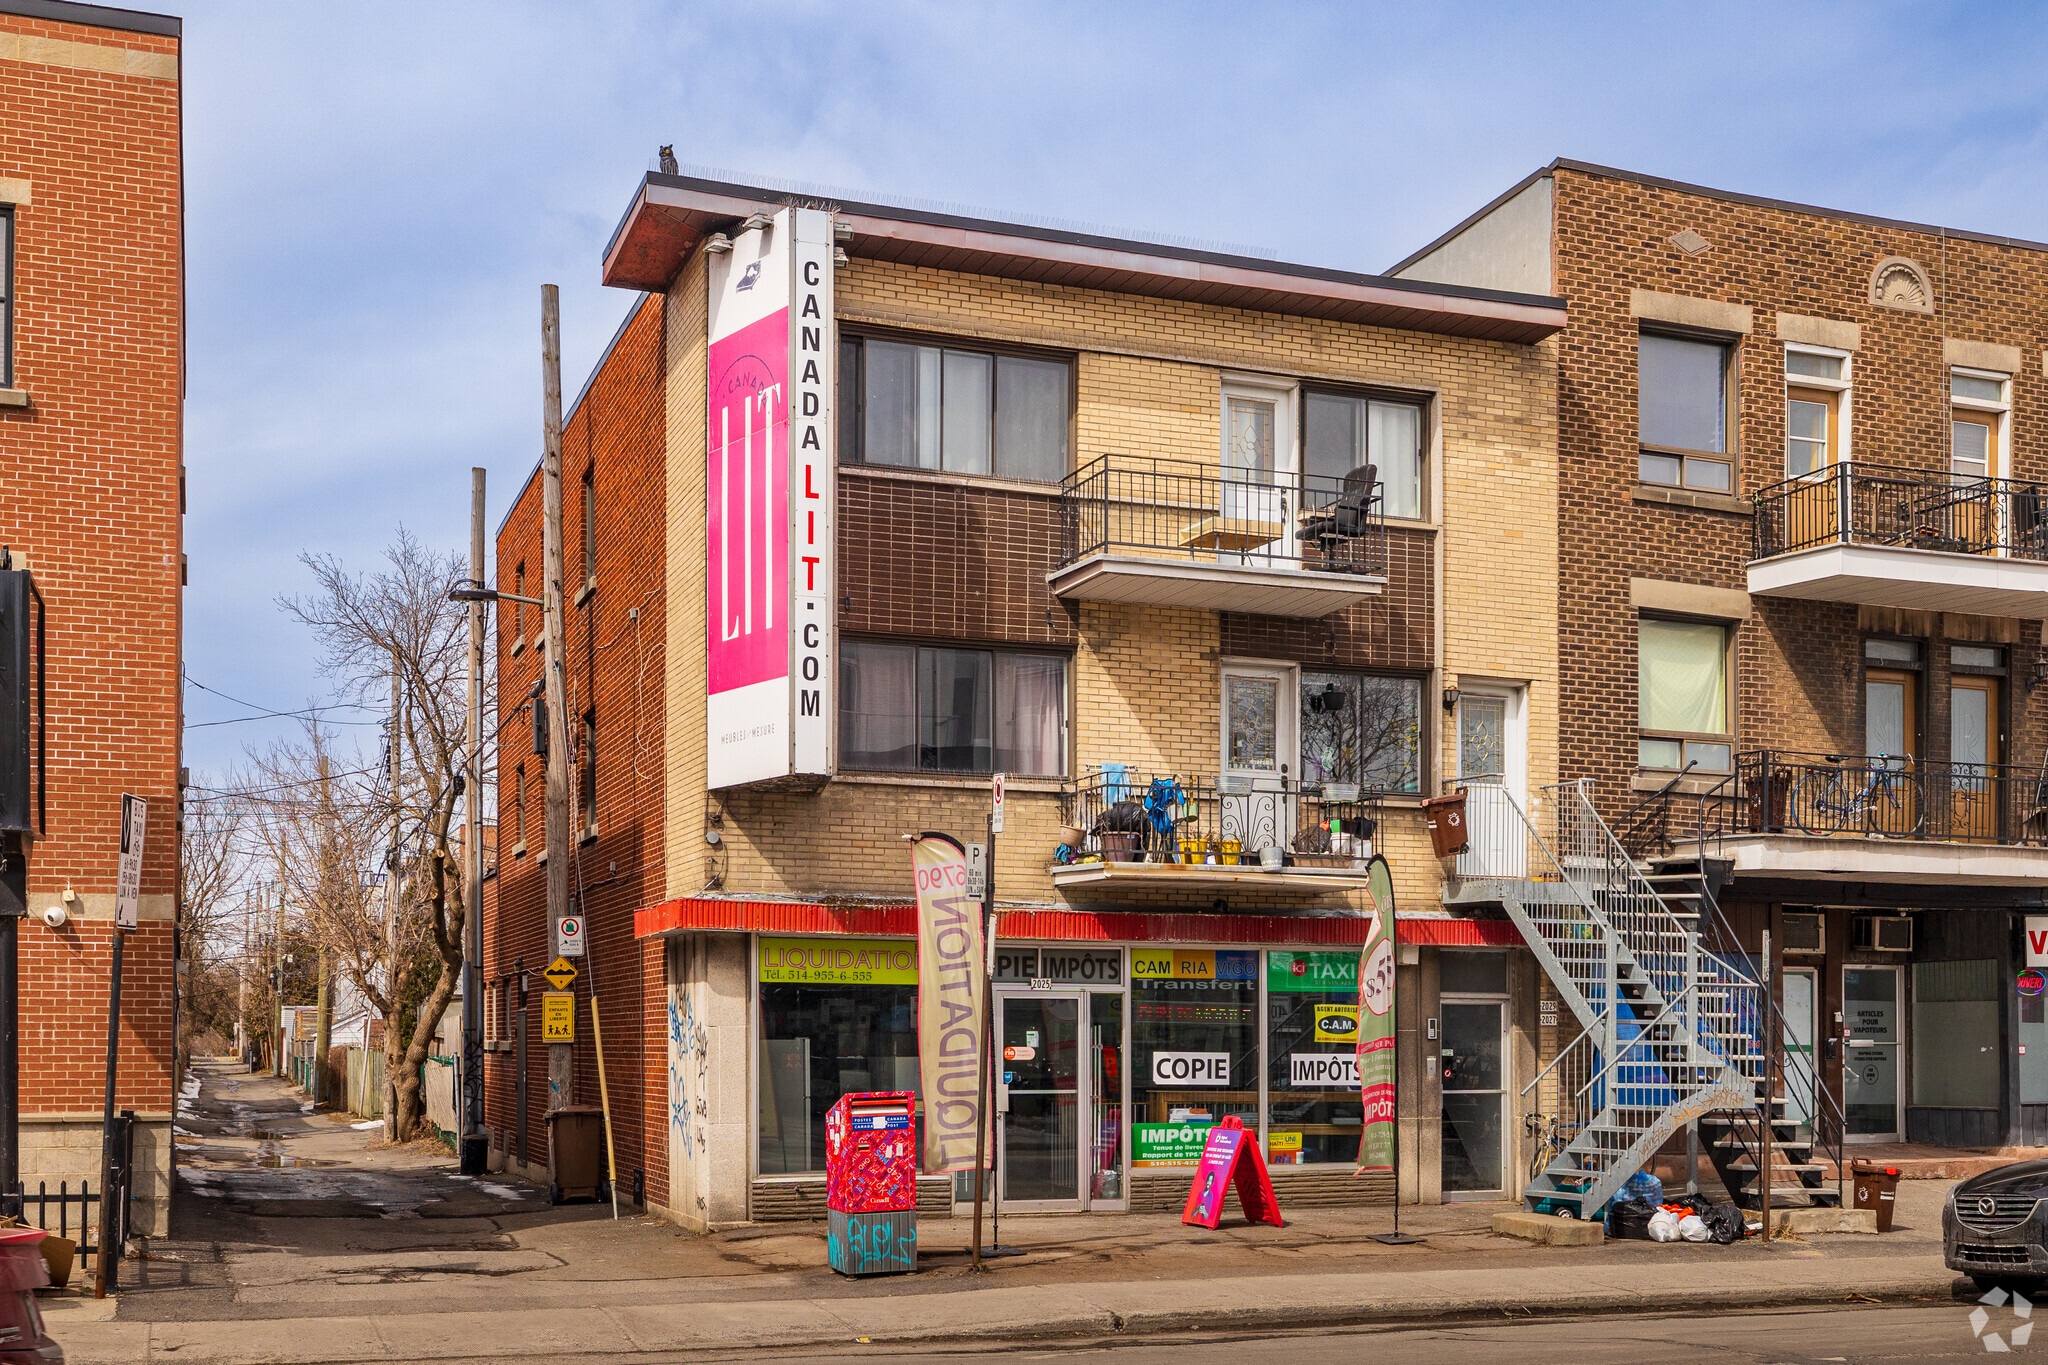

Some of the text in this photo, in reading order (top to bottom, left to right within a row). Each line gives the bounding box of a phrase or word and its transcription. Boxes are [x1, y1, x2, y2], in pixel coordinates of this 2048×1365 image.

[721, 382, 781, 642] LIT
[752, 723, 775, 738] MESURE
[972, 847, 980, 865] P
[764, 947, 918, 970] LIQUIDATIO
[997, 953, 1119, 980] PIE IMPÔTS
[1134, 960, 1256, 976] CAM RIA VIGO
[1292, 962, 1355, 979] ici TAXI
[788, 970, 873, 981] 514-955-6-555
[1032, 979, 1050, 989] 2025
[1136, 978, 1255, 991] Transfert
[1321, 1019, 1355, 1030] C.A.M.
[1541, 1015, 1557, 1024] 2027
[1004, 1048, 1015, 1056] ria
[1156, 1058, 1228, 1079] COPIE
